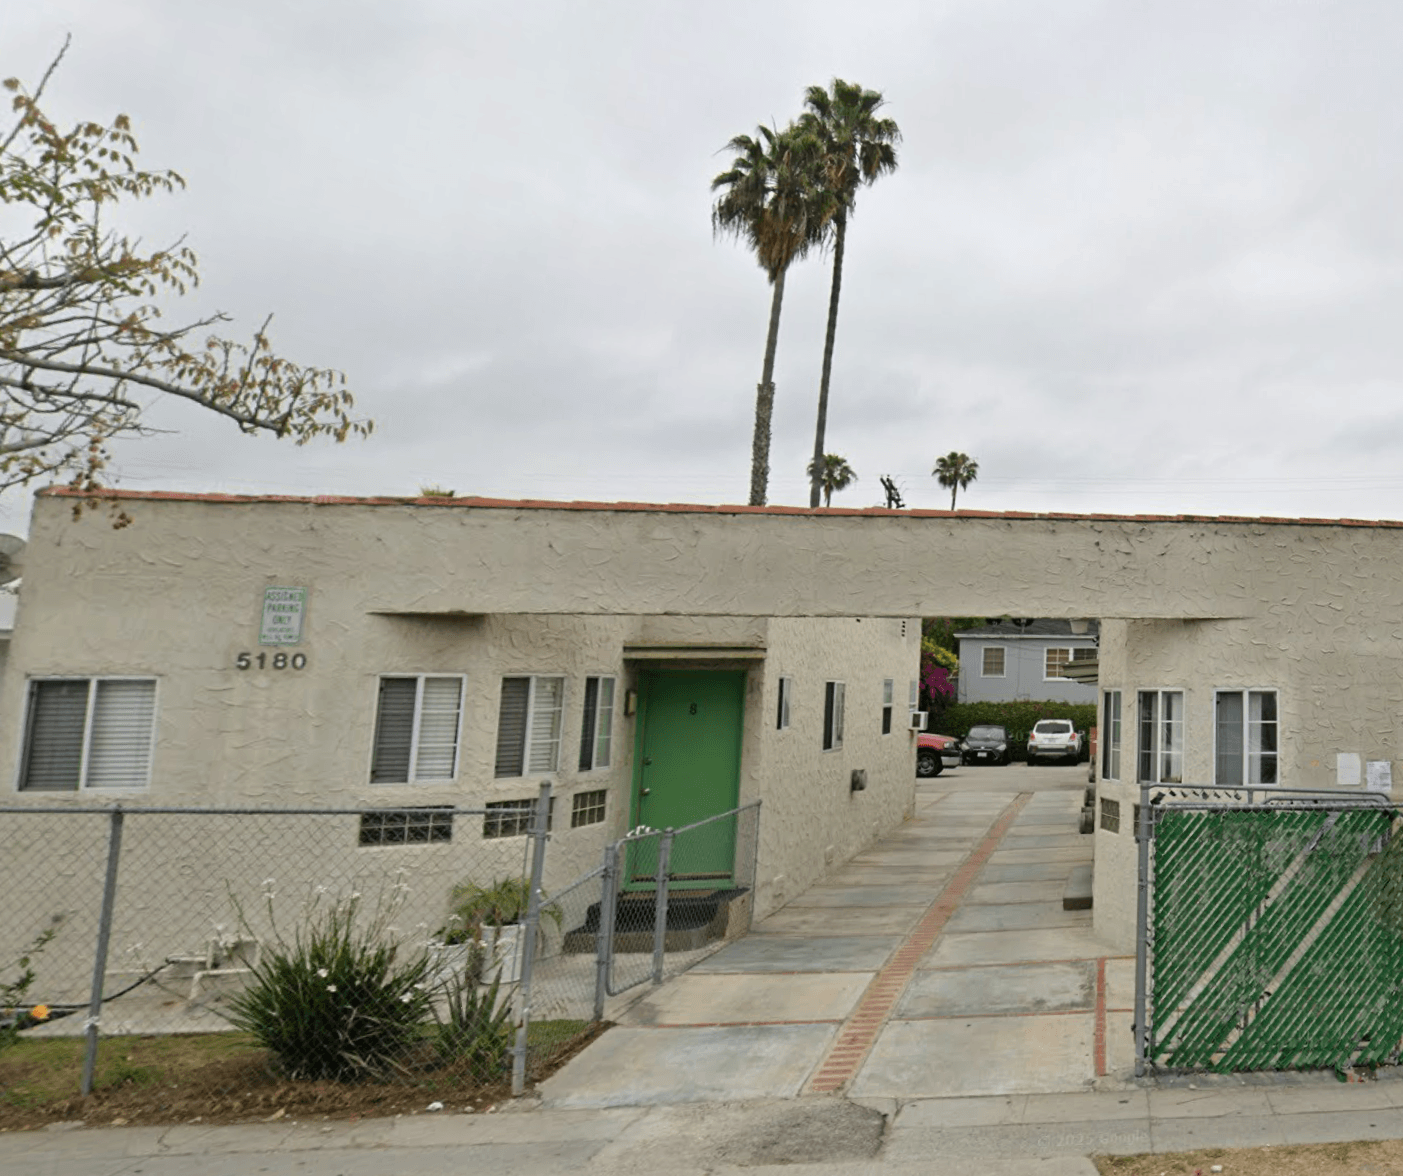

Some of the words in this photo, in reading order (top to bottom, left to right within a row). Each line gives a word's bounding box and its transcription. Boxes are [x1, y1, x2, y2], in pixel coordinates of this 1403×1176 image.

[267, 603, 300, 613] PARKING
[272, 615, 292, 625] ONLY
[236, 651, 307, 671] 5180
[689, 702, 698, 716] 8
